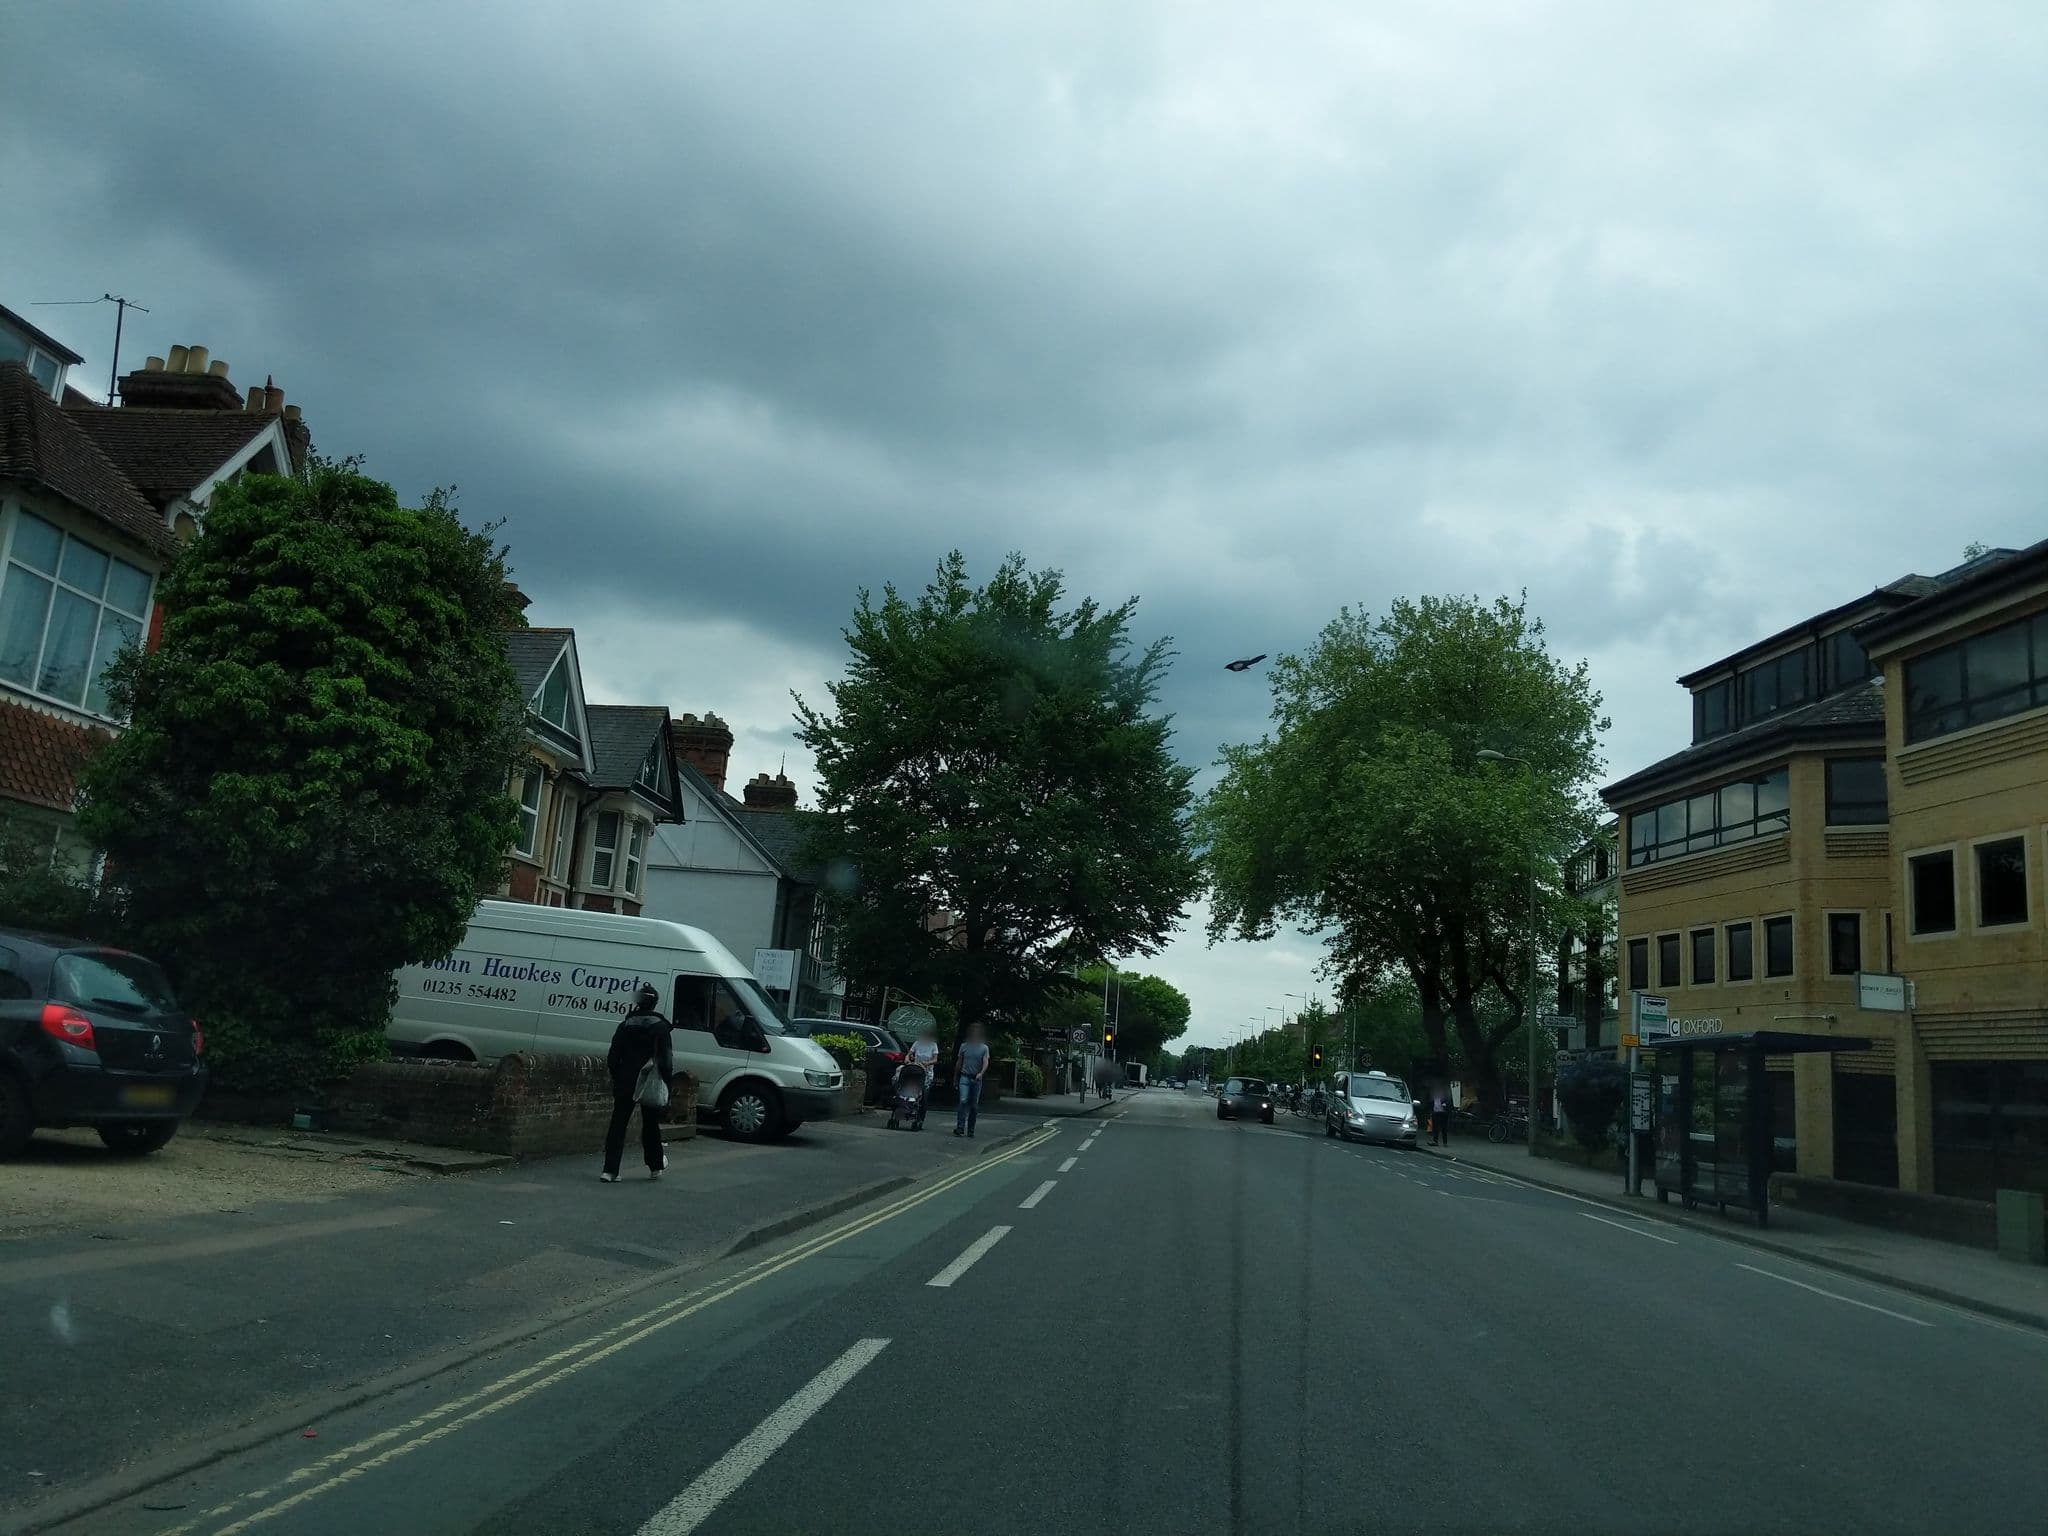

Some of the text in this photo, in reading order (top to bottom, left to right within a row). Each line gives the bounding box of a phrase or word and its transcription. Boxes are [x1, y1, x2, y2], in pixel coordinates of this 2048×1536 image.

[481, 957, 562, 984] Hawkes
[423, 978, 517, 1002] 01235 554482
[547, 993, 588, 1010] 07768
[1683, 1018, 1723, 1034] OXFORD
[1074, 1032, 1085, 1041] 20
